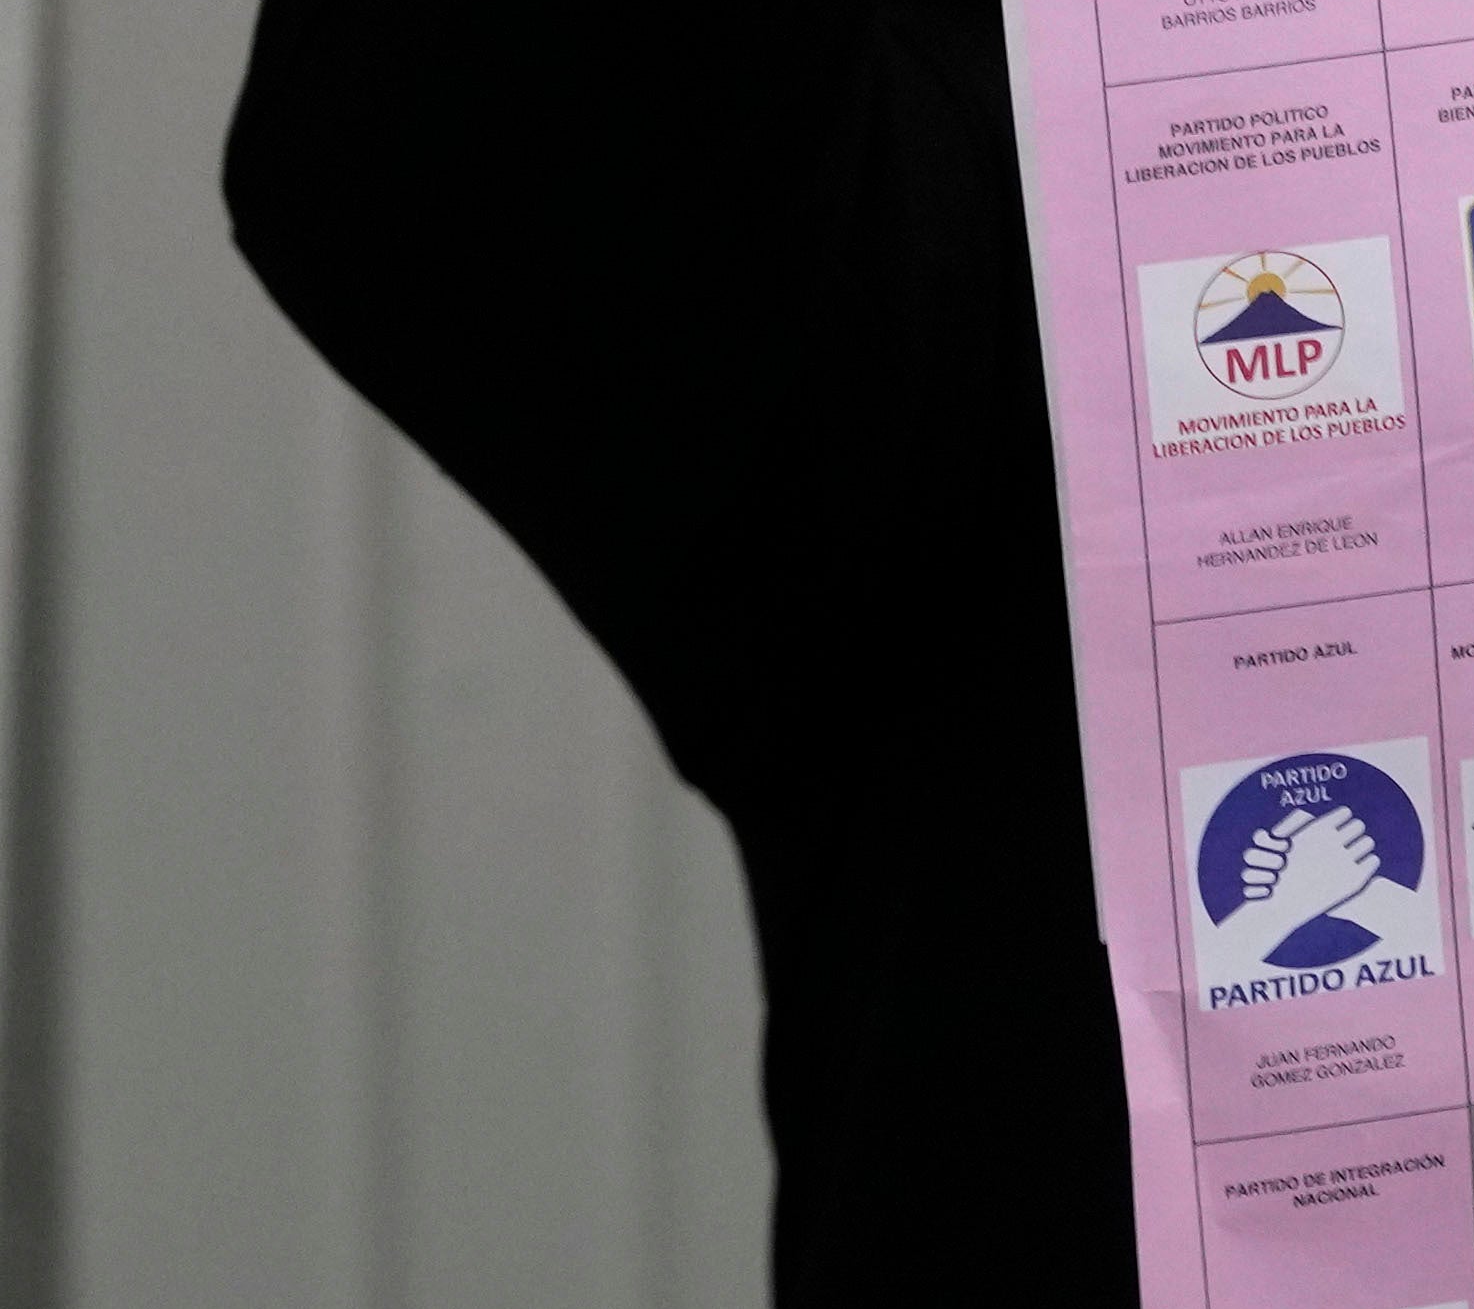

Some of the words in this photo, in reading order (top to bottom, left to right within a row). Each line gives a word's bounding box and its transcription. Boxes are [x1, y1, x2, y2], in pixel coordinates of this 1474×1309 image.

[1170, 115, 1246, 138] PARTIDO
[1249, 105, 1329, 128] POLITICO
[1158, 133, 1266, 159] MOVIMIENTO
[1270, 126, 1318, 146] PARA
[1322, 123, 1345, 139] LA
[1124, 157, 1229, 184] LIBERACION
[1233, 154, 1258, 170] DE
[1261, 149, 1297, 167] LOS
[1300, 138, 1381, 161] PUEBLOS
[1226, 339, 1323, 384] MLP
[1178, 406, 1299, 436] MOVIMIENTO
[1304, 400, 1352, 420] PARA
[1356, 397, 1378, 414] LA
[1151, 433, 1258, 459] LIBERACION
[1262, 429, 1286, 447] DE
[1290, 425, 1323, 443] LOS
[1327, 414, 1407, 439] PUEBLOS
[1232, 646, 1309, 670] PARTIDO
[1314, 641, 1358, 659] AZUL
[1260, 762, 1348, 790] PARTIDO
[1279, 785, 1332, 807] AZUL
[1210, 968, 1345, 1011] PARTIDO
[1355, 955, 1435, 988] AZUL
[1293, 1183, 1379, 1208] NACIONAL
